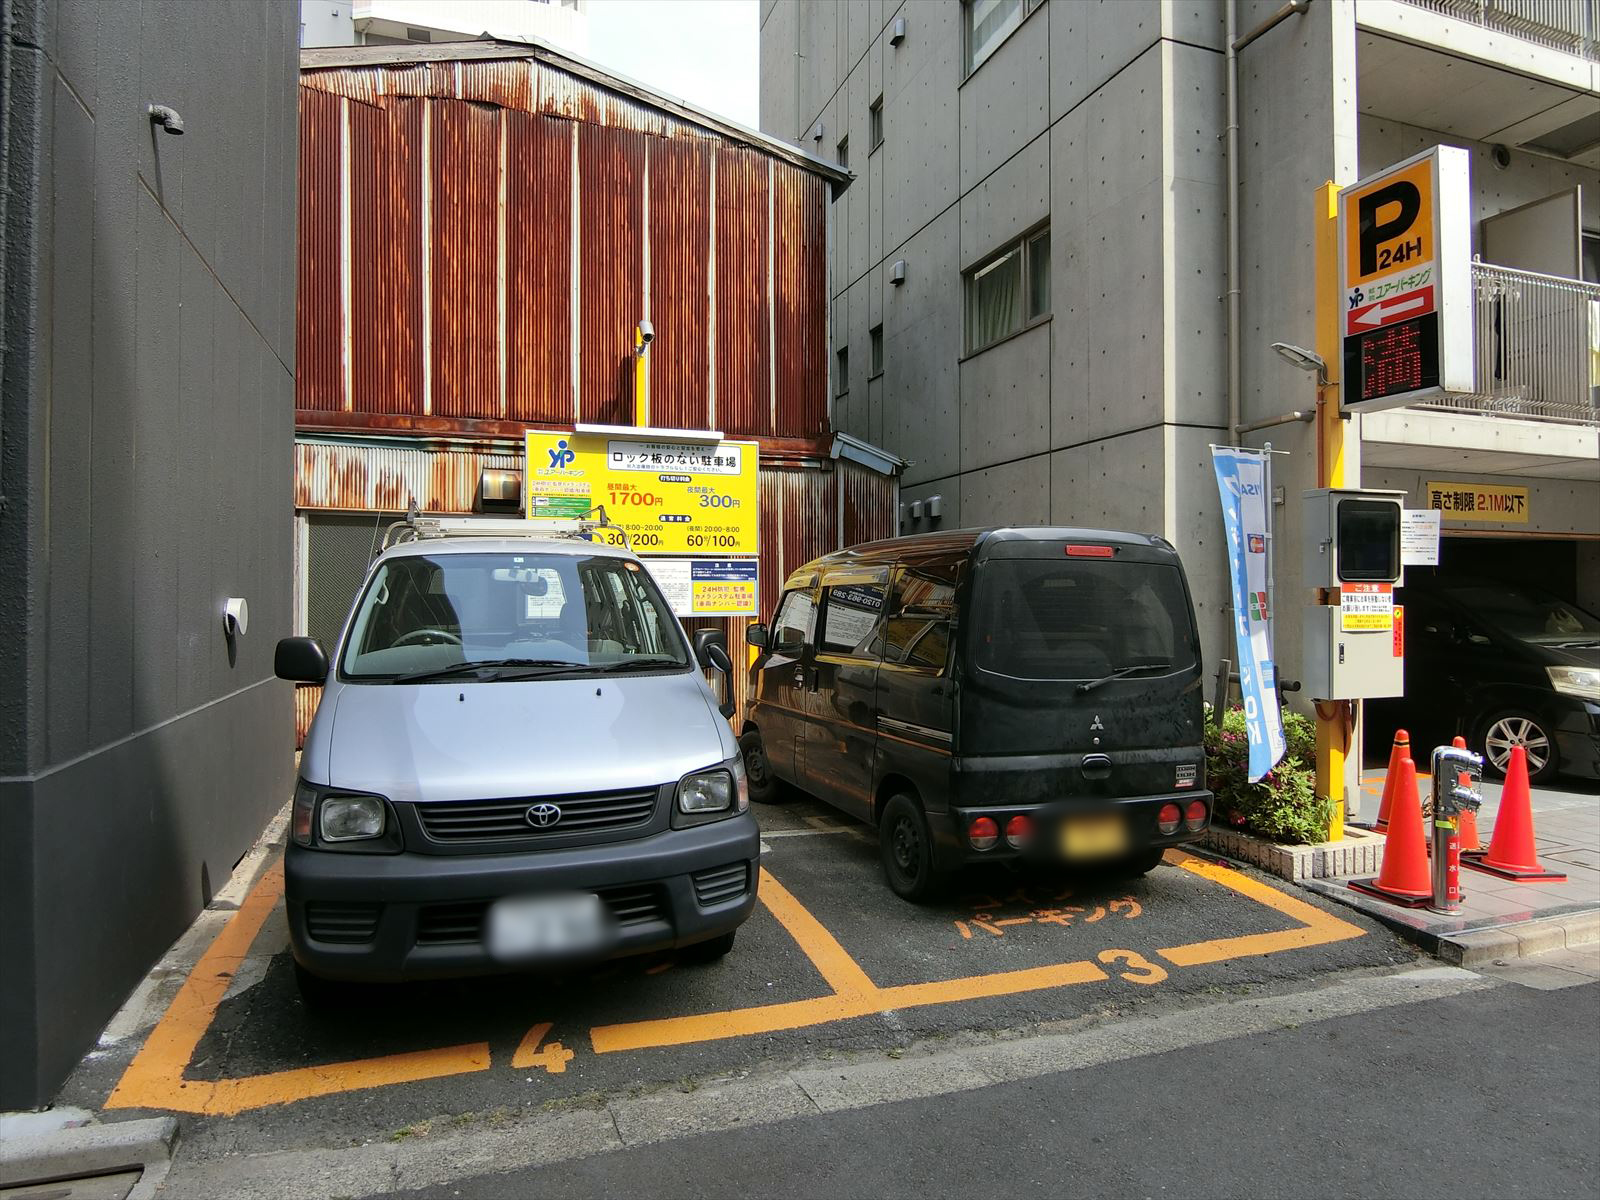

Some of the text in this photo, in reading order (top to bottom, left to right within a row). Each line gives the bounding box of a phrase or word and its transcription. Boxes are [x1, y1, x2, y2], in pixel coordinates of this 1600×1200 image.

[1359, 181, 1421, 277] P
[1379, 237, 1422, 271] 24H
[1363, 326, 1421, 397] 満
[613, 451, 737, 468] ロック板のない駐車場
[607, 483, 637, 491] 昼間最大
[687, 486, 715, 494] 夜間最大
[609, 492, 663, 506] 1700円
[699, 494, 740, 508] 300円
[1431, 490, 1475, 512] 高さ制限
[1098, 948, 1169, 985] 3
[512, 1022, 575, 1073] 4
